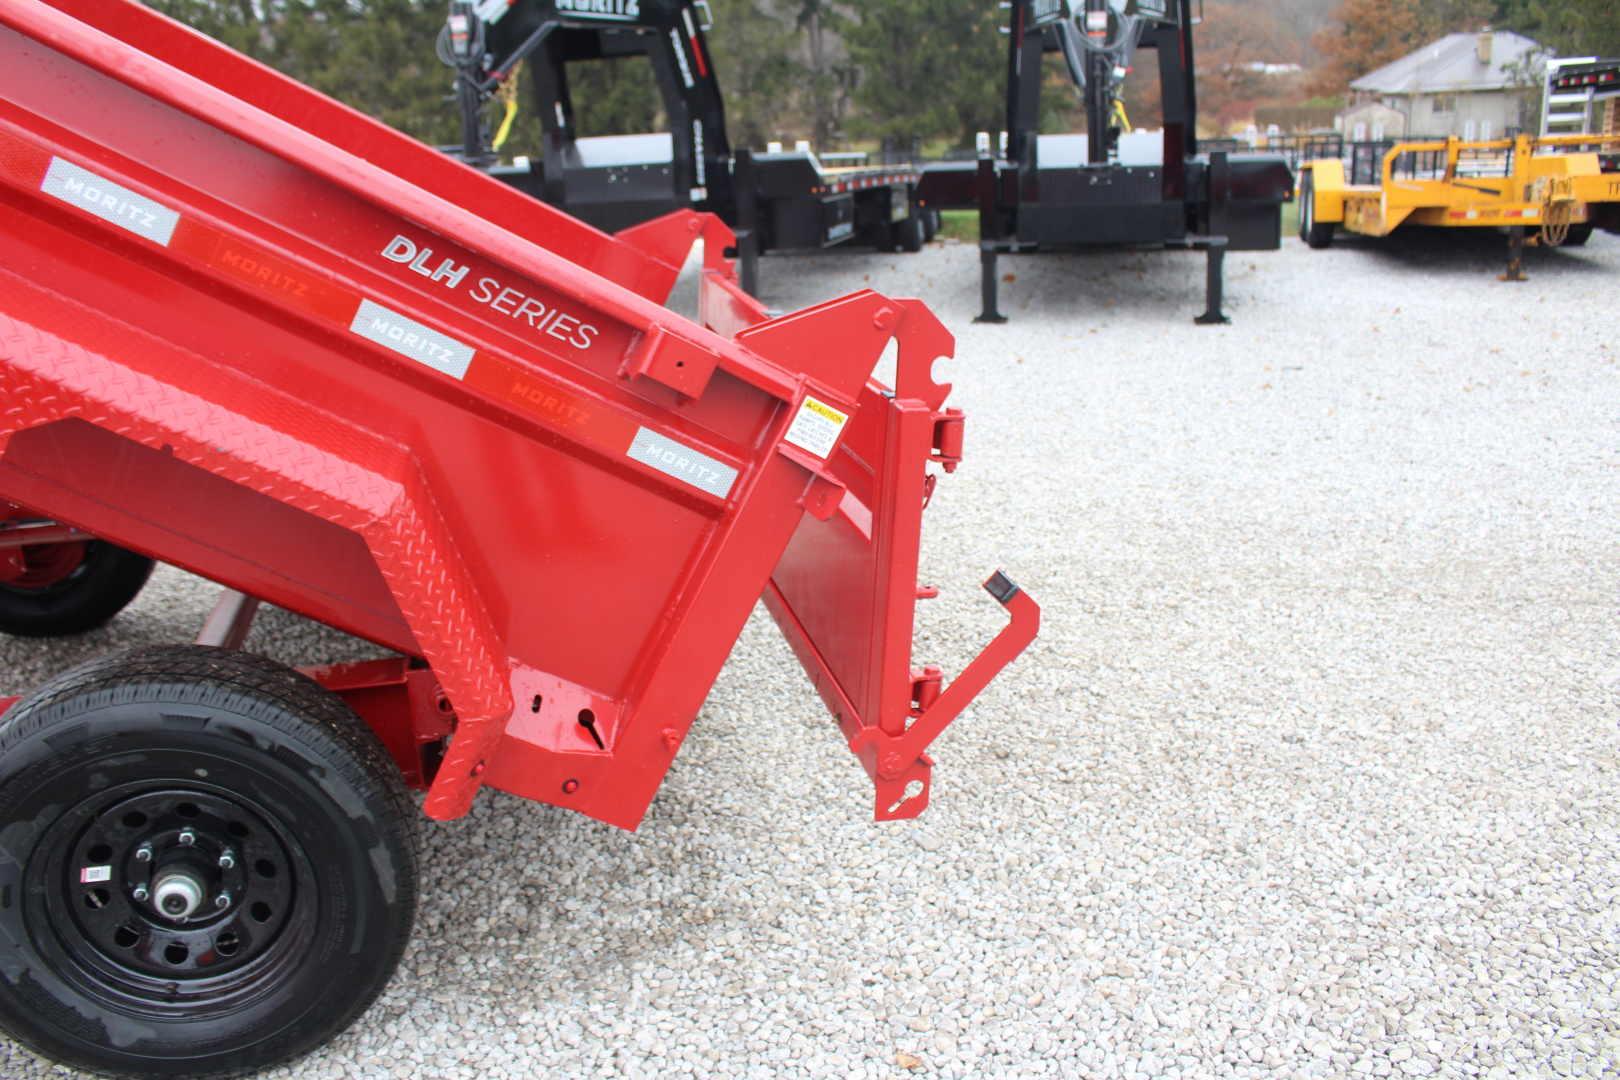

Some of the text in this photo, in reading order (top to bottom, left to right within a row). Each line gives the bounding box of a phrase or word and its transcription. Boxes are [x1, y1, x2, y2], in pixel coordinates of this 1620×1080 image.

[64, 177, 158, 229] MORITZ
[220, 250, 309, 298] MORITZ
[380, 234, 600, 350] DLH SERIES
[370, 317, 456, 363] MORITZ
[511, 382, 592, 426] MORITZ
[812, 404, 844, 424] CAUTION
[645, 443, 722, 485] MORITZ
[789, 430, 828, 453] MOVING TRAILER
